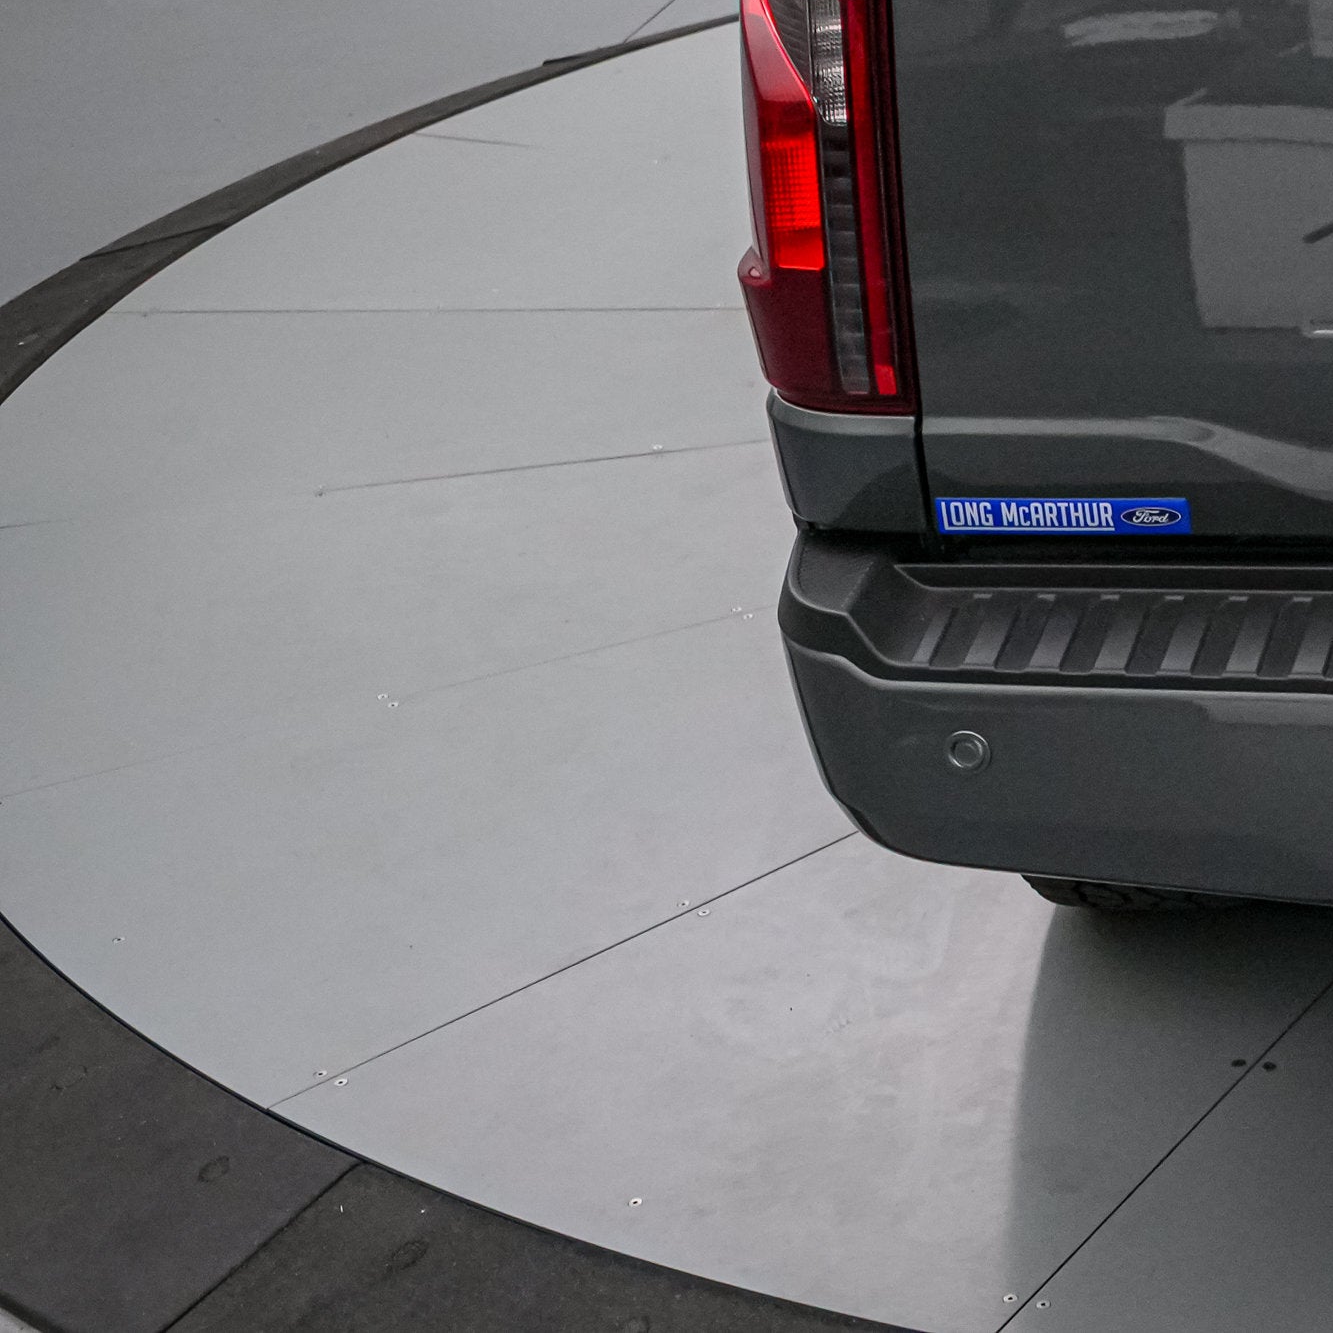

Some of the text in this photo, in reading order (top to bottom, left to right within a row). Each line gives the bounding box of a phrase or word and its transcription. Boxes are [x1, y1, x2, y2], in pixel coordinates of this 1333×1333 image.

[940, 501, 1114, 528] LONG McARTHUR
[1132, 509, 1169, 524] Ford
